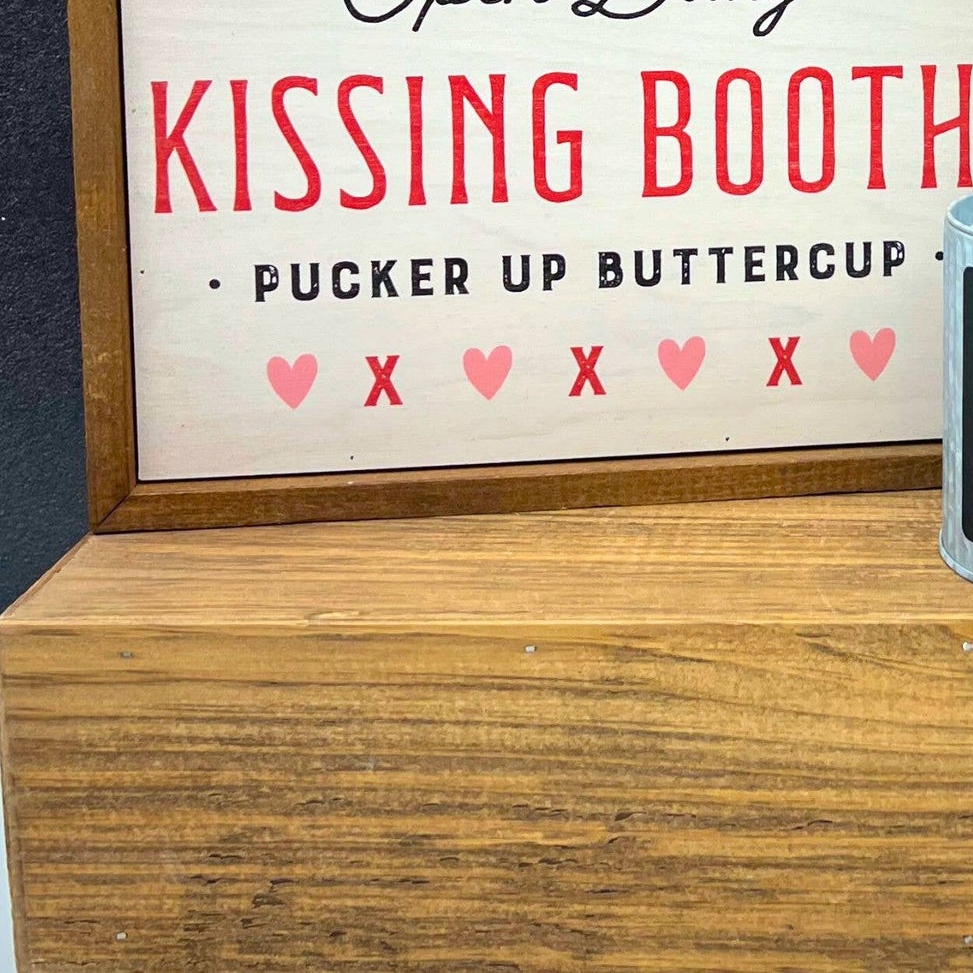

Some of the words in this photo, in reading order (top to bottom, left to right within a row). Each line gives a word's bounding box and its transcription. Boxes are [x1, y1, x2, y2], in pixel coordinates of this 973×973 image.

[151, 71, 583, 214] KISSING
[640, 64, 973, 198] BOOTH
[254, 258, 469, 303] PUCKER
[501, 253, 567, 293] UP
[598, 240, 905, 289] BUTTERCUP
[364, 354, 402, 407] X
[569, 345, 605, 397] X
[768, 336, 802, 387] X
